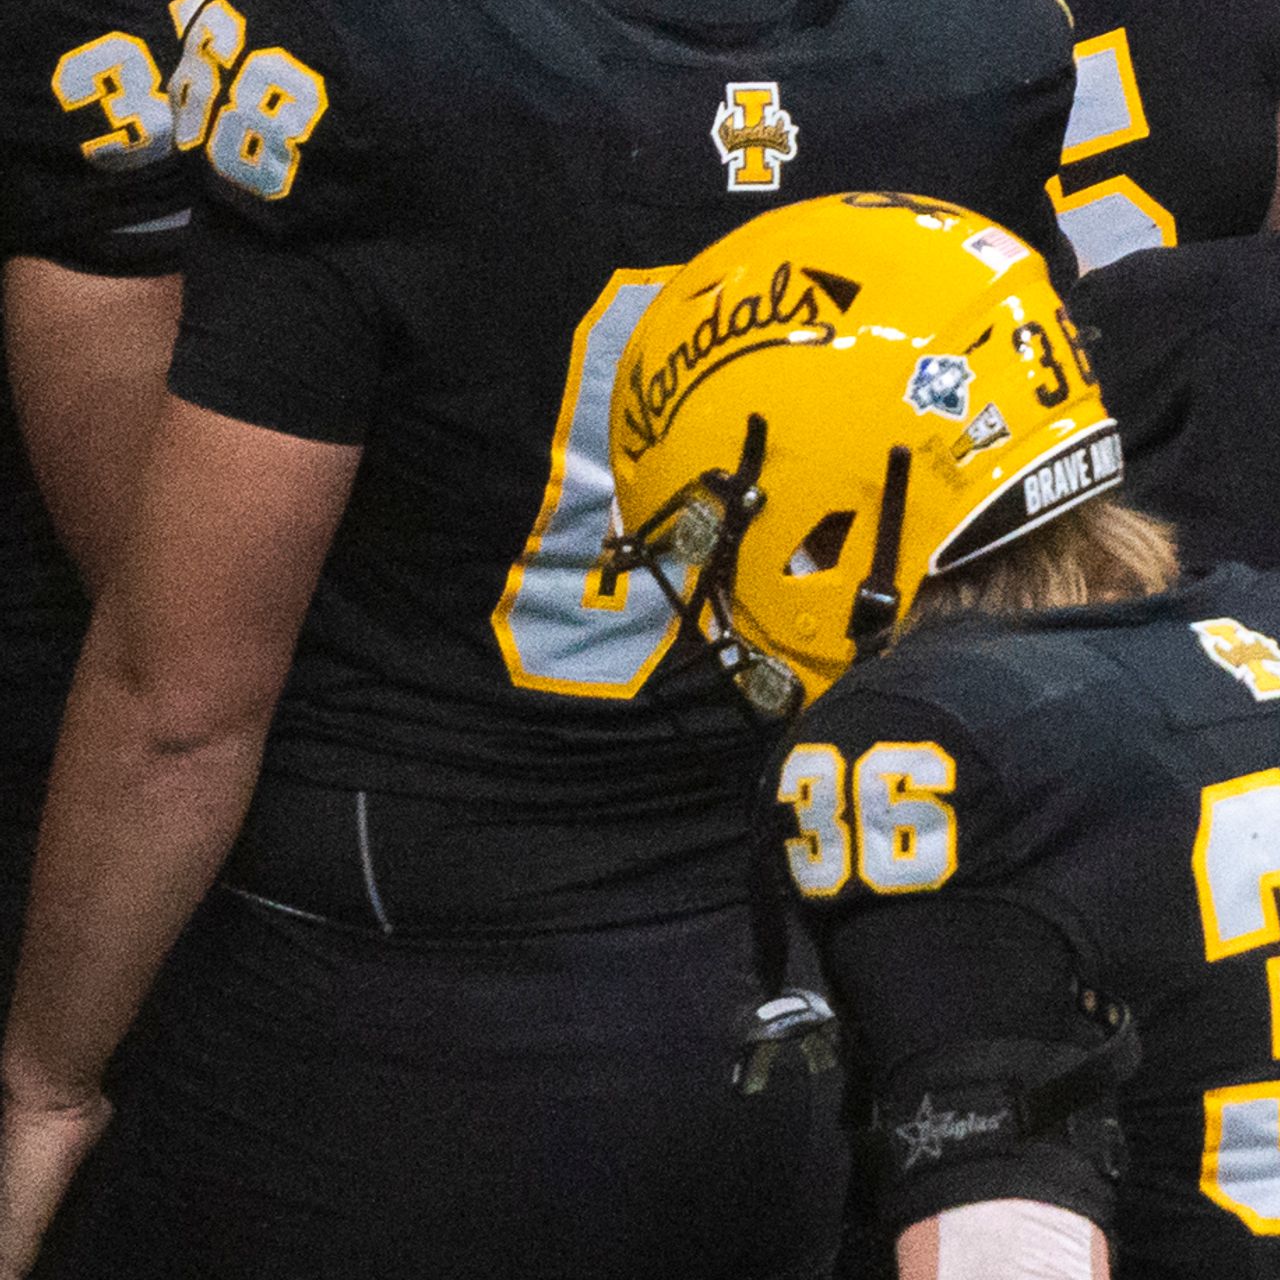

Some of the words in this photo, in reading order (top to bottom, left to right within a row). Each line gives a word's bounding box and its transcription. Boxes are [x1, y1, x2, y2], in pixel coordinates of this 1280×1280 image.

[624, 261, 821, 448] Vandals
[1023, 447, 1092, 517] BRAVE
[776, 739, 957, 899] 36
